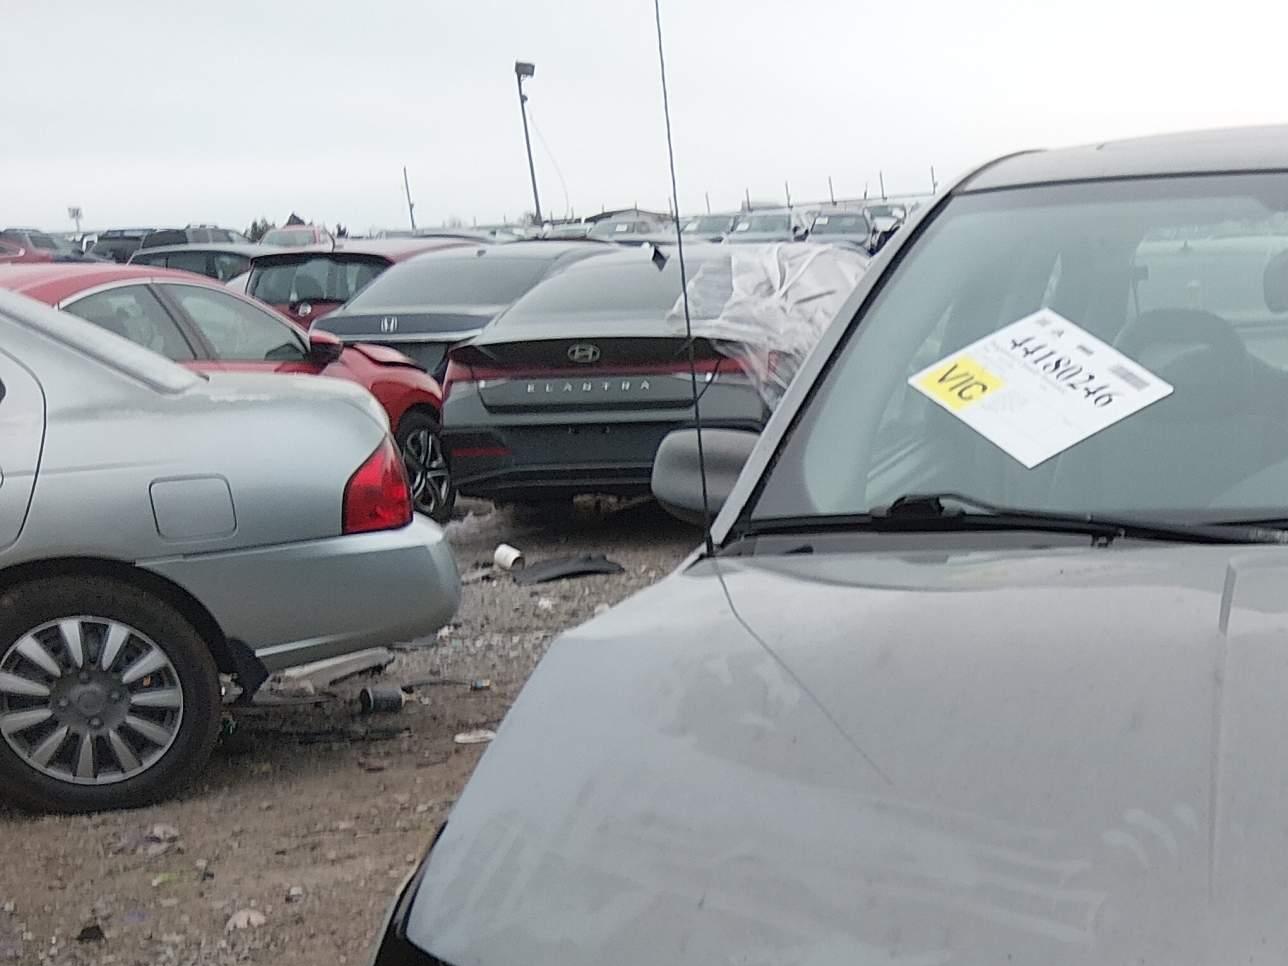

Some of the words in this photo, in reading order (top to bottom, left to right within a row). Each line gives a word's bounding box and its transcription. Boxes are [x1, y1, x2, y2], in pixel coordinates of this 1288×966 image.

[526, 379, 651, 393] ELANTRA
[937, 363, 988, 401] VIC
[1010, 336, 1116, 408] 44180246
